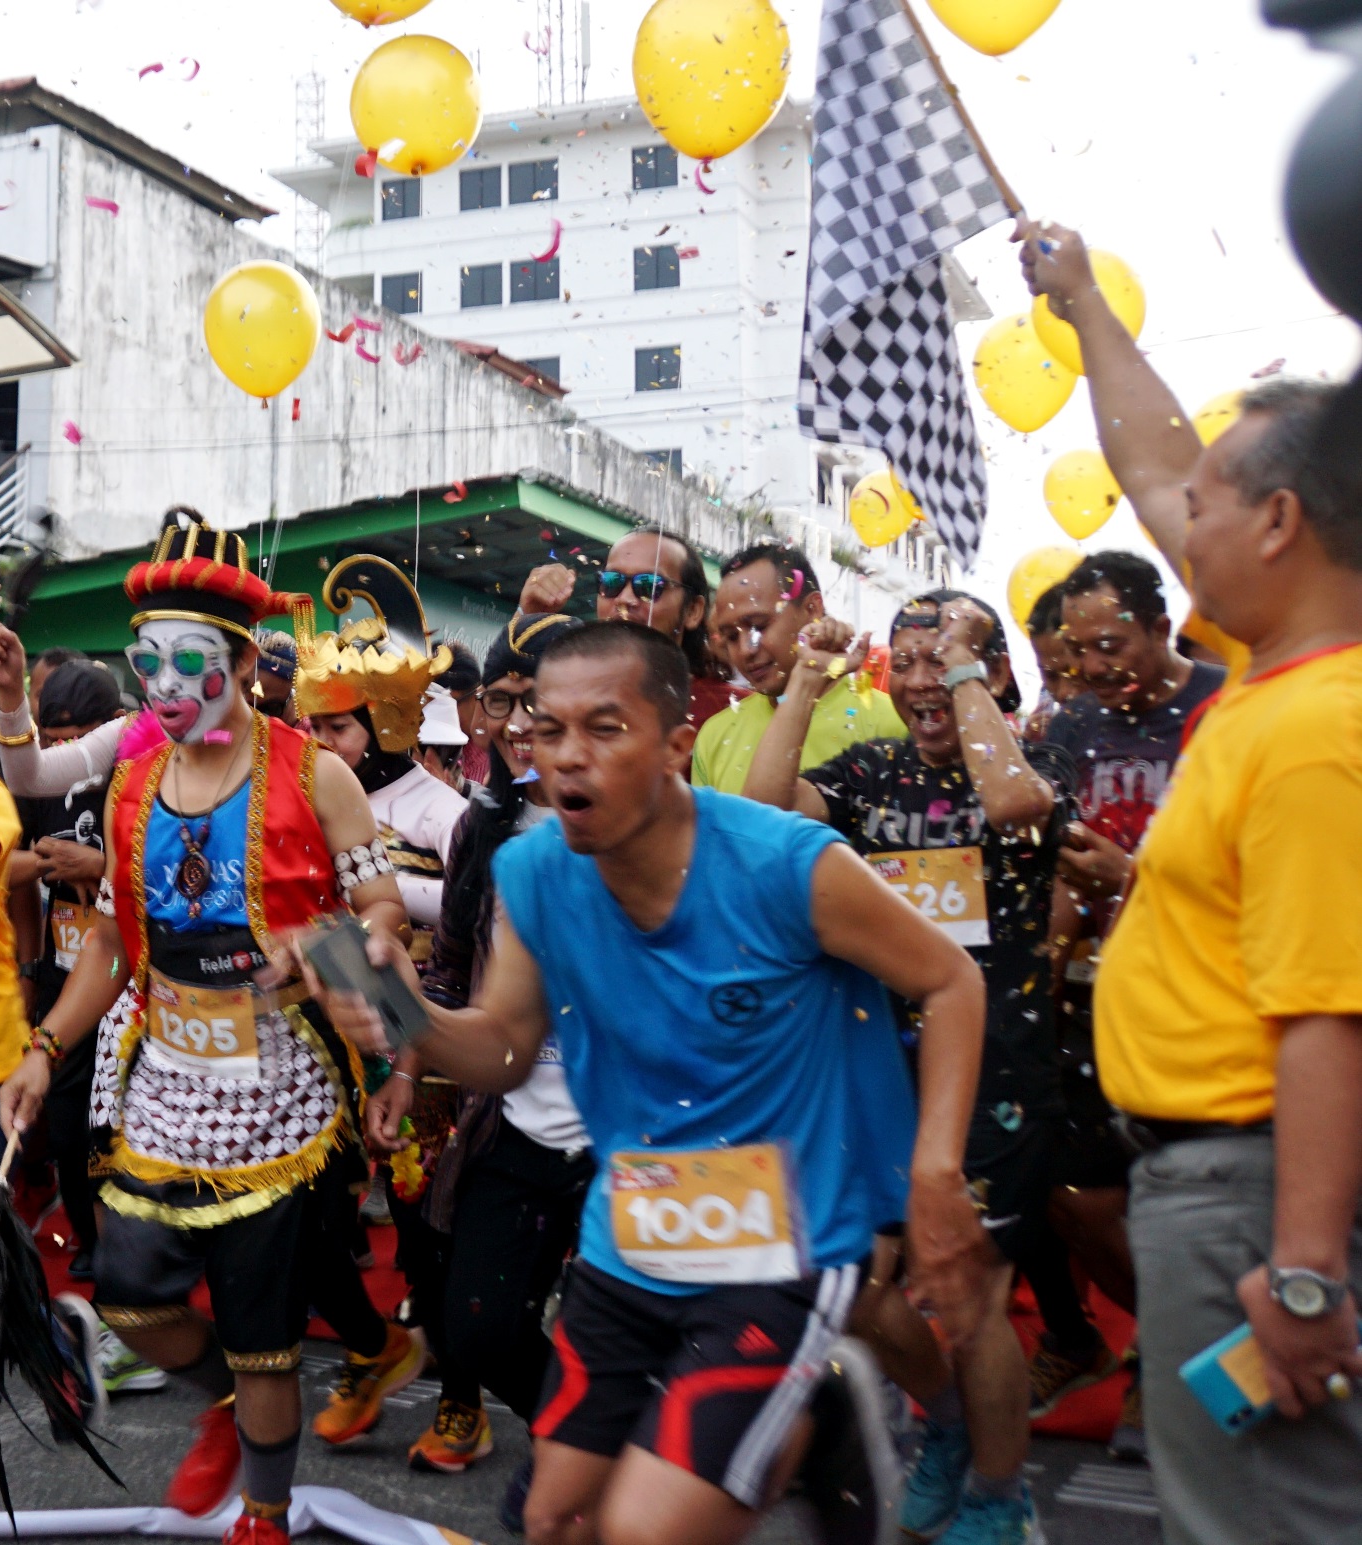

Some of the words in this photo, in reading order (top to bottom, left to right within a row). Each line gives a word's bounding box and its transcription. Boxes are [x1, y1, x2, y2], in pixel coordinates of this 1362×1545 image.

[200, 954, 234, 974] Field
[157, 1005, 240, 1054] 1295
[625, 1188, 776, 1245] 1004
